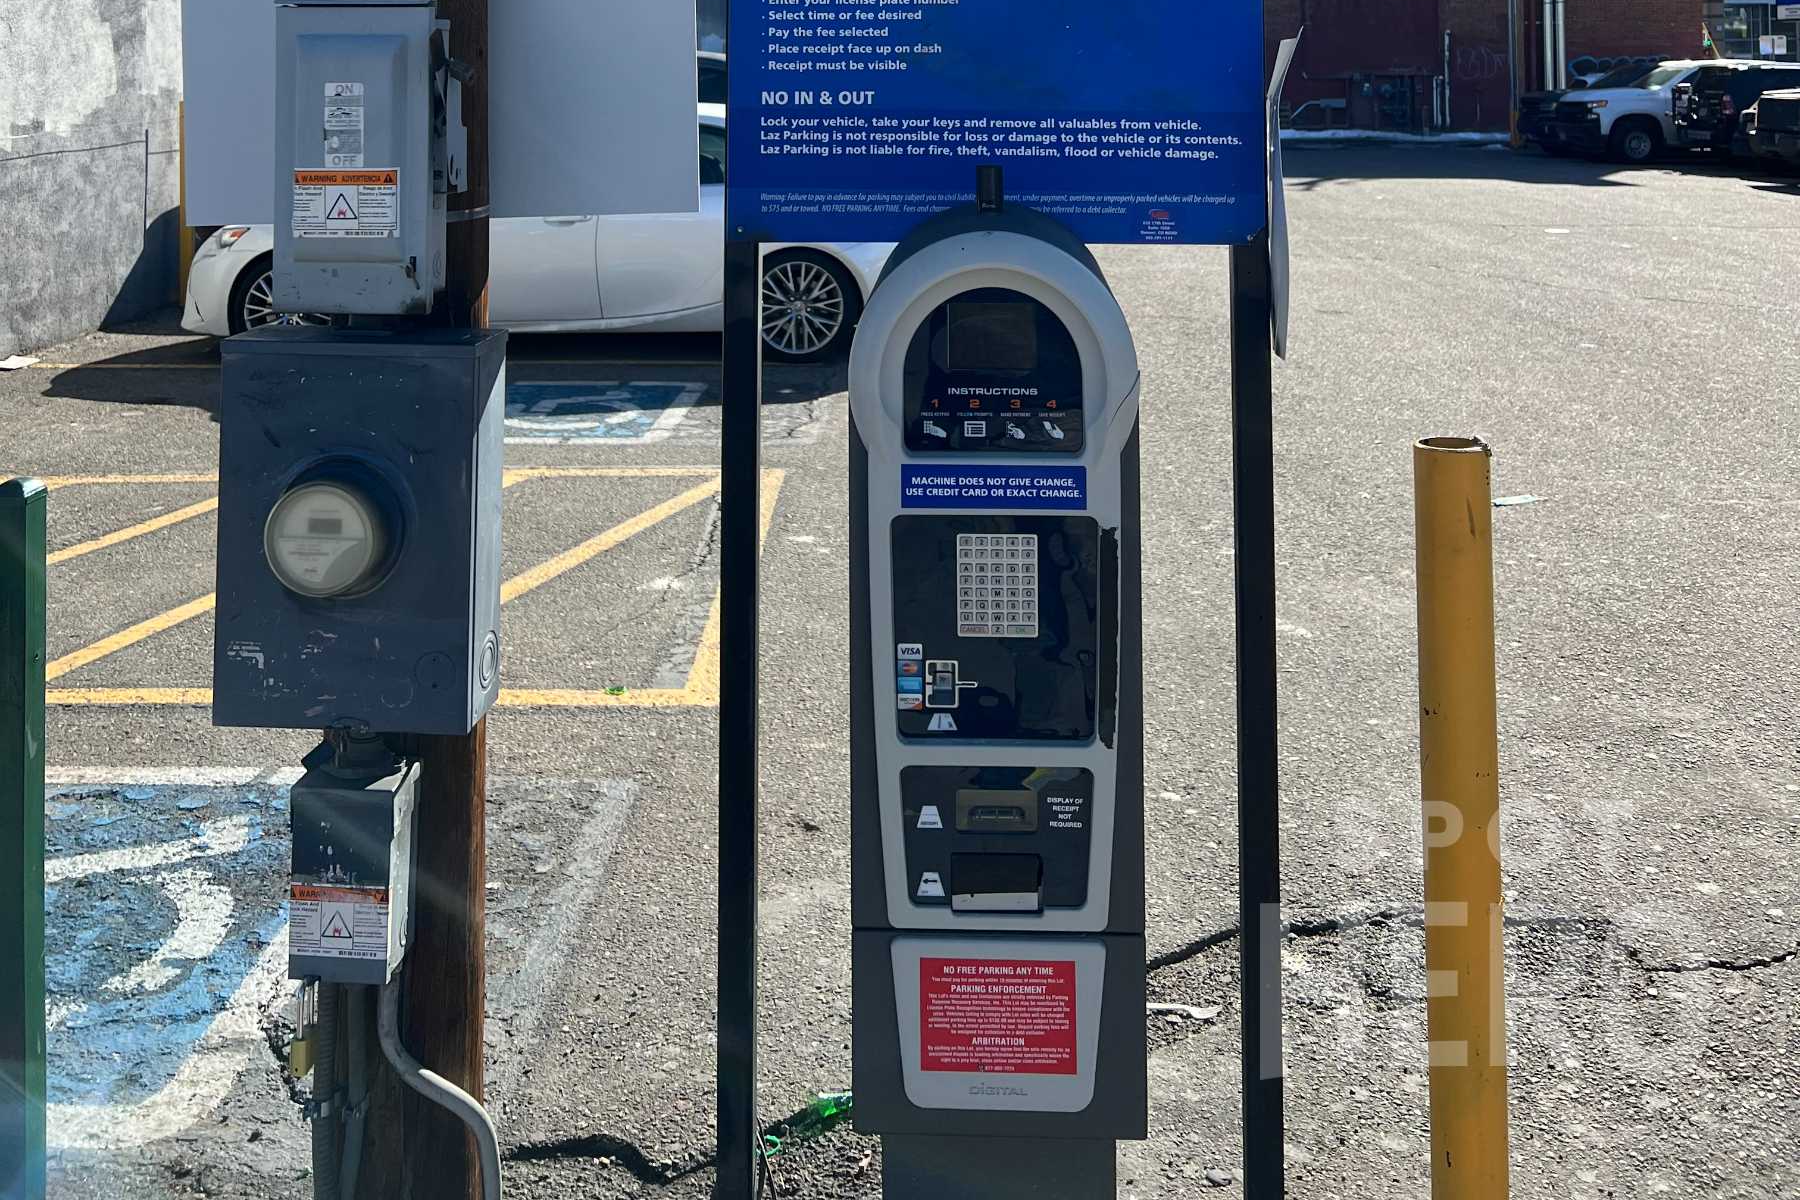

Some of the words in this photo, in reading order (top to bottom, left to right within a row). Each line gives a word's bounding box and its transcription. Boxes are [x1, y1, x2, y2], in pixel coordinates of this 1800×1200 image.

[768, 10, 804, 20] Select
[807, 10, 835, 20] time
[838, 12, 852, 20] or
[855, 9, 874, 20] fee
[877, 9, 921, 20] desired
[768, 27, 789, 39] Pay
[793, 26, 813, 36] the
[816, 26, 835, 36] fee
[839, 26, 888, 36] selected
[768, 43, 799, 53] Place
[802, 43, 844, 55] receipt
[847, 43, 872, 53] face
[876, 45, 891, 55] up
[894, 45, 910, 53] on
[913, 42, 941, 53] dash
[768, 60, 812, 72] Receipt
[815, 60, 846, 70] must
[849, 59, 864, 70] be
[867, 59, 906, 69] visible
[761, 91, 788, 104] NO
[794, 91, 813, 104] IN
[819, 90, 832, 104] &
[838, 90, 874, 104] OUT
[760, 115, 787, 126] Lock
[791, 118, 819, 128] your
[822, 116, 868, 127] vehicle,
[871, 116, 898, 126] take
[901, 119, 930, 129] your
[933, 116, 960, 129] keys
[963, 117, 986, 127] and
[990, 119, 1036, 128] remove
[1039, 118, 1054, 128] all
[1058, 118, 1116, 129] valuables
[1119, 118, 1150, 129] from
[1154, 119, 1201, 130] vehicle.
[760, 130, 780, 140] Laz
[783, 129, 829, 142] Parking
[832, 130, 842, 140] is
[845, 131, 866, 140] not
[870, 130, 939, 143] responsible
[943, 130, 961, 141] for
[965, 131, 988, 141] loss
[991, 133, 1005, 141] or
[1008, 131, 1057, 144] damage
[1060, 132, 1074, 142] to
[1077, 132, 1098, 142] the
[1101, 132, 1145, 143] vehicle
[1148, 135, 1162, 143] or
[1165, 133, 1180, 144] its
[1184, 135, 1242, 145] contents.
[760, 144, 780, 154] Laz
[783, 143, 828, 156] Parking
[832, 144, 842, 154] is
[845, 145, 866, 154] not
[870, 144, 903, 154] liable
[906, 144, 925, 154] for
[928, 144, 952, 156] fire,
[956, 145, 990, 157] theft,
[994, 145, 1060, 157] vandalism,
[1064, 146, 1097, 156] flood
[1100, 149, 1114, 157] or
[1117, 147, 1161, 157] vehicle
[1164, 147, 1218, 161] damage.
[332, 155, 358, 167] OFF
[301, 175, 338, 183] WARNING
[341, 175, 382, 183] ADVERTENCIA
[947, 387, 1038, 395] INSTRUCTIONS
[931, 399, 939, 408] 1
[969, 399, 981, 408] 2
[1009, 399, 1021, 408] 3
[1046, 399, 1057, 408] 4
[911, 476, 956, 485] MACHINE
[958, 477, 984, 485] DOES
[986, 477, 1006, 485] NOT
[1008, 477, 1031, 486] GIVE
[1033, 478, 1075, 487] CHANGE,
[905, 487, 923, 495] USE
[926, 488, 959, 496] CREDIT
[961, 488, 988, 496] CARD
[990, 488, 1004, 496] OR
[1006, 488, 1037, 497] EXACT
[1039, 489, 1082, 497] CHANGE.
[900, 647, 920, 655] VISA
[943, 965, 954, 974] NO
[957, 966, 976, 974] FREE
[978, 966, 1013, 974] PARKING
[1015, 966, 1032, 975] ANY
[1034, 966, 1053, 975] TIME
[950, 984, 986, 993] PARKING
[987, 985, 1046, 993] ENFORCEMENT
[971, 1037, 1024, 1045] ARBITRATION
